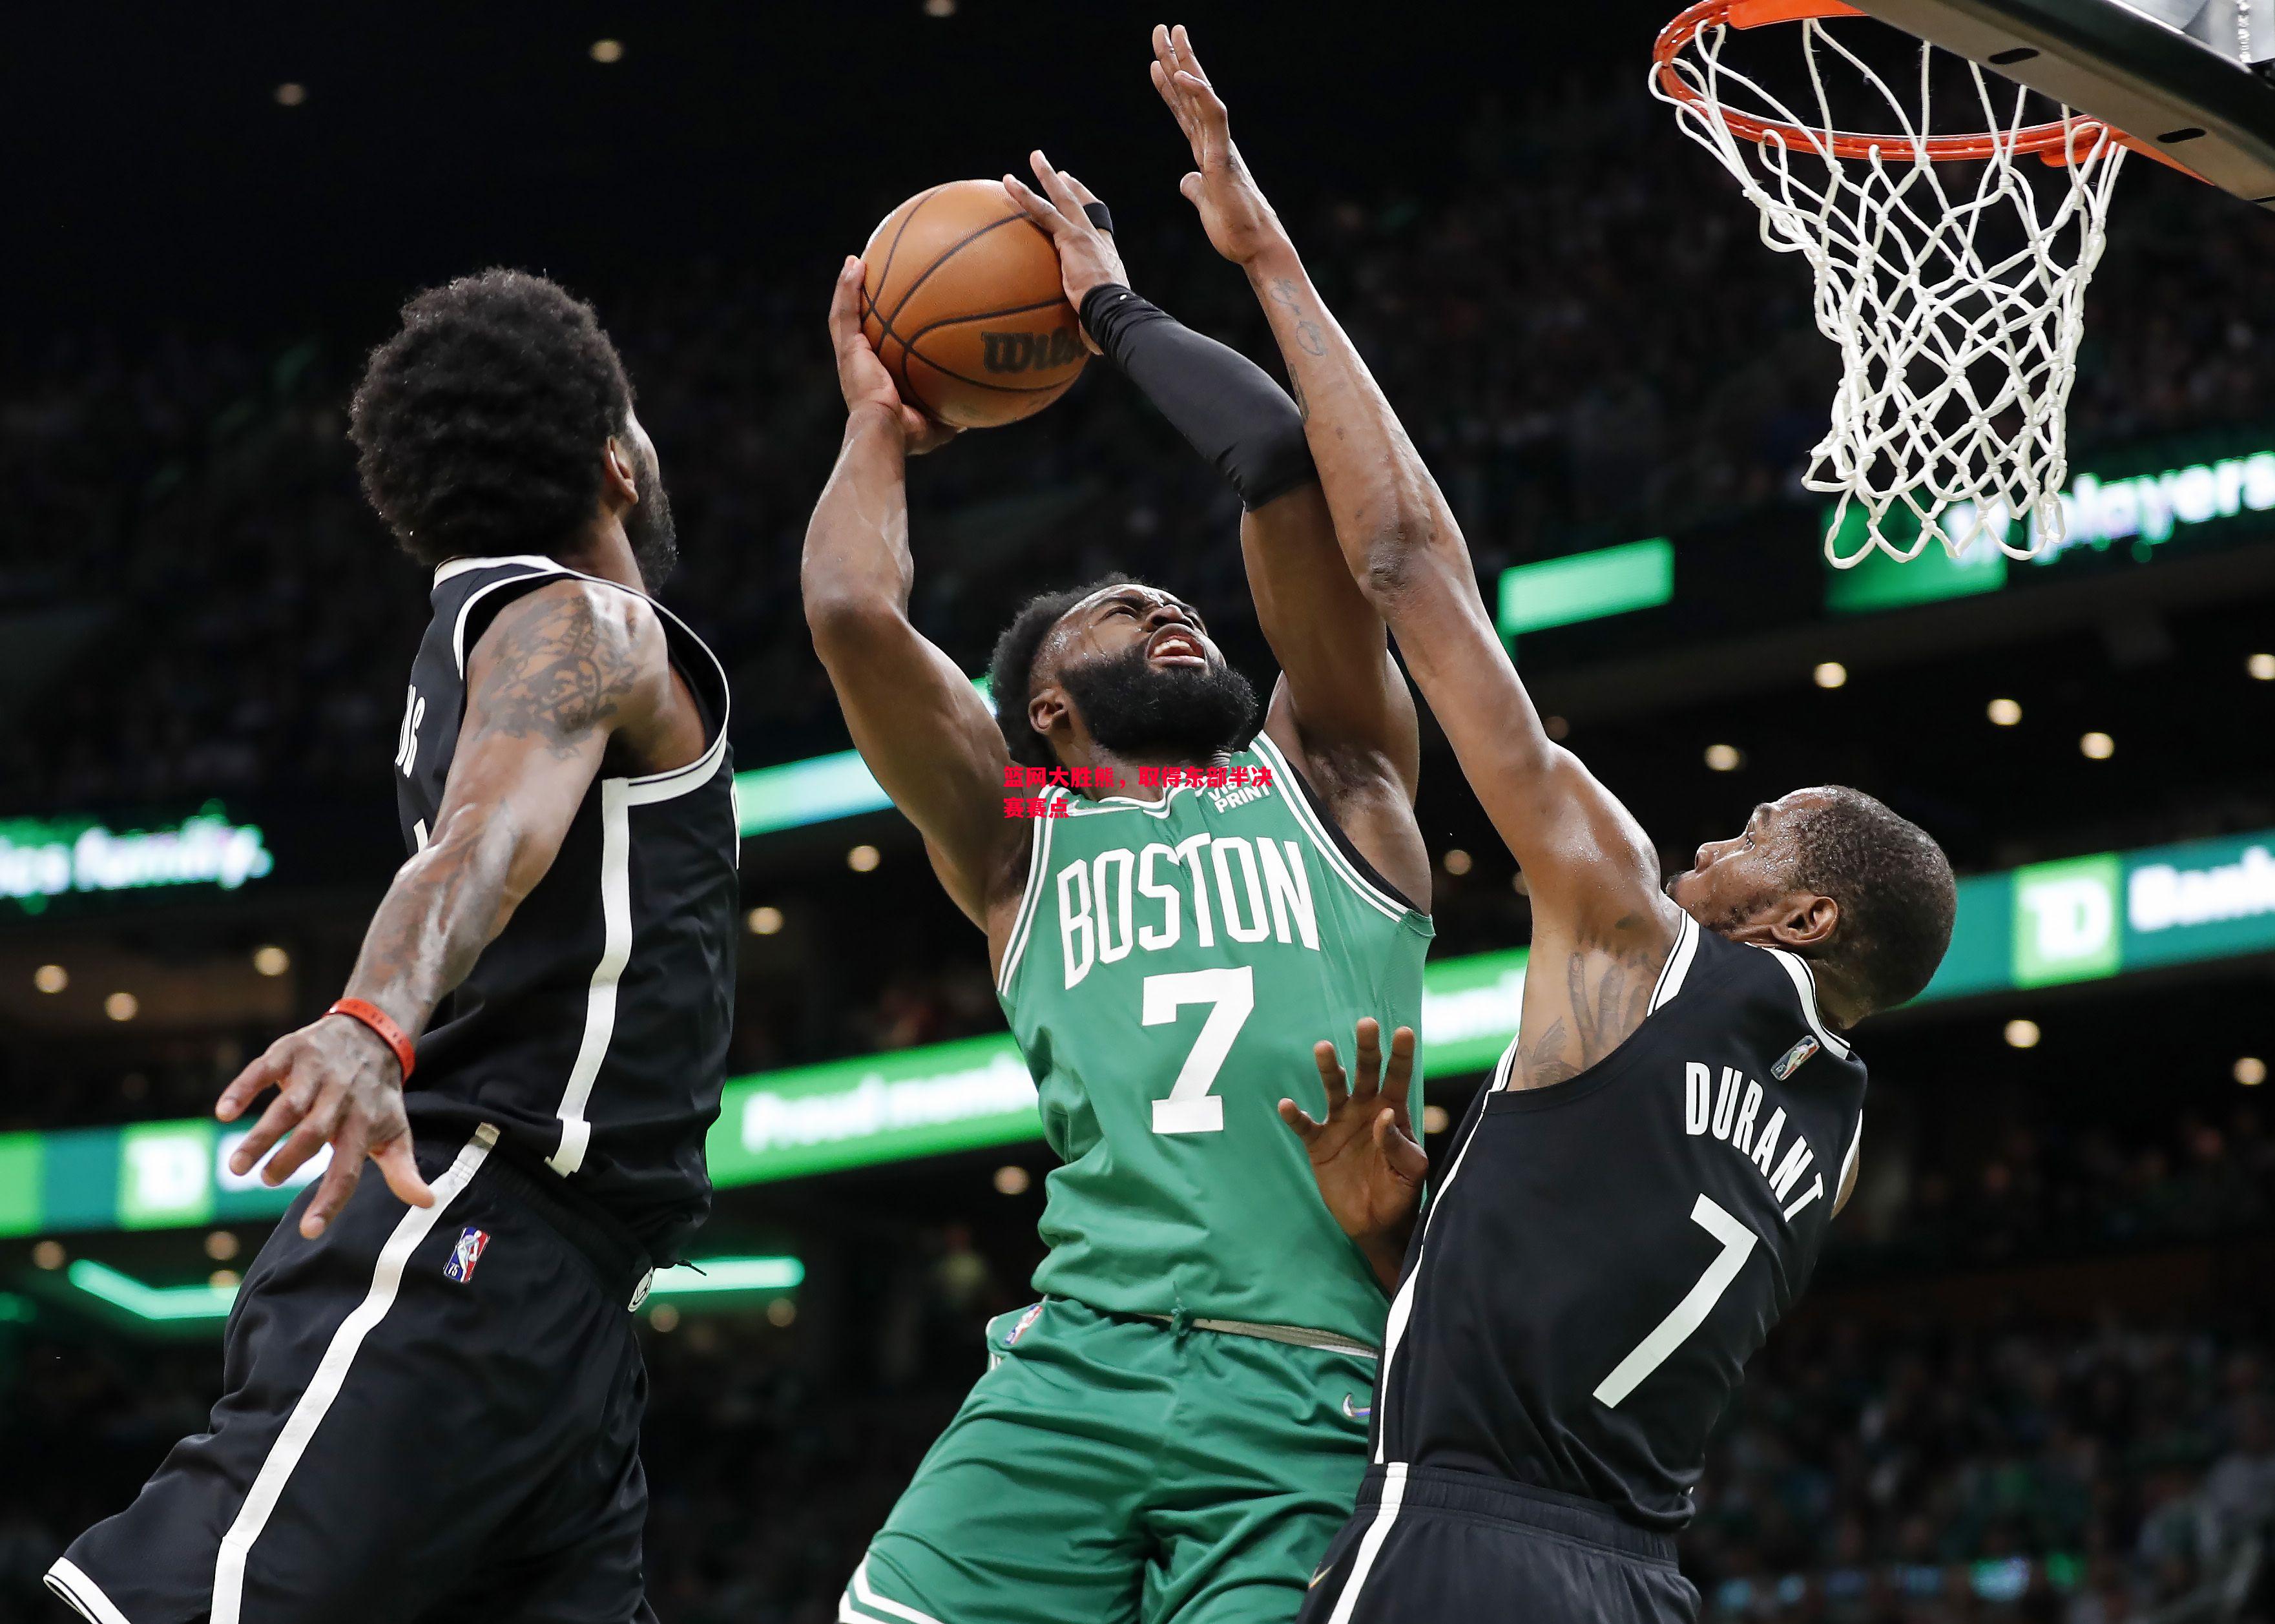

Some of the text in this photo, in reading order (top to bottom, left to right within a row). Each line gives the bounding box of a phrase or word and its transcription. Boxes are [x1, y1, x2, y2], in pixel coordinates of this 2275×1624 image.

[1214, 778, 1271, 813] PRINT
[1057, 833, 1320, 990] BOSTON
[2019, 877, 2112, 963] TD
[1142, 965, 1254, 1134] 7
[1686, 1061, 1825, 1222] DURANT
[1593, 1192, 1758, 1408] 7
